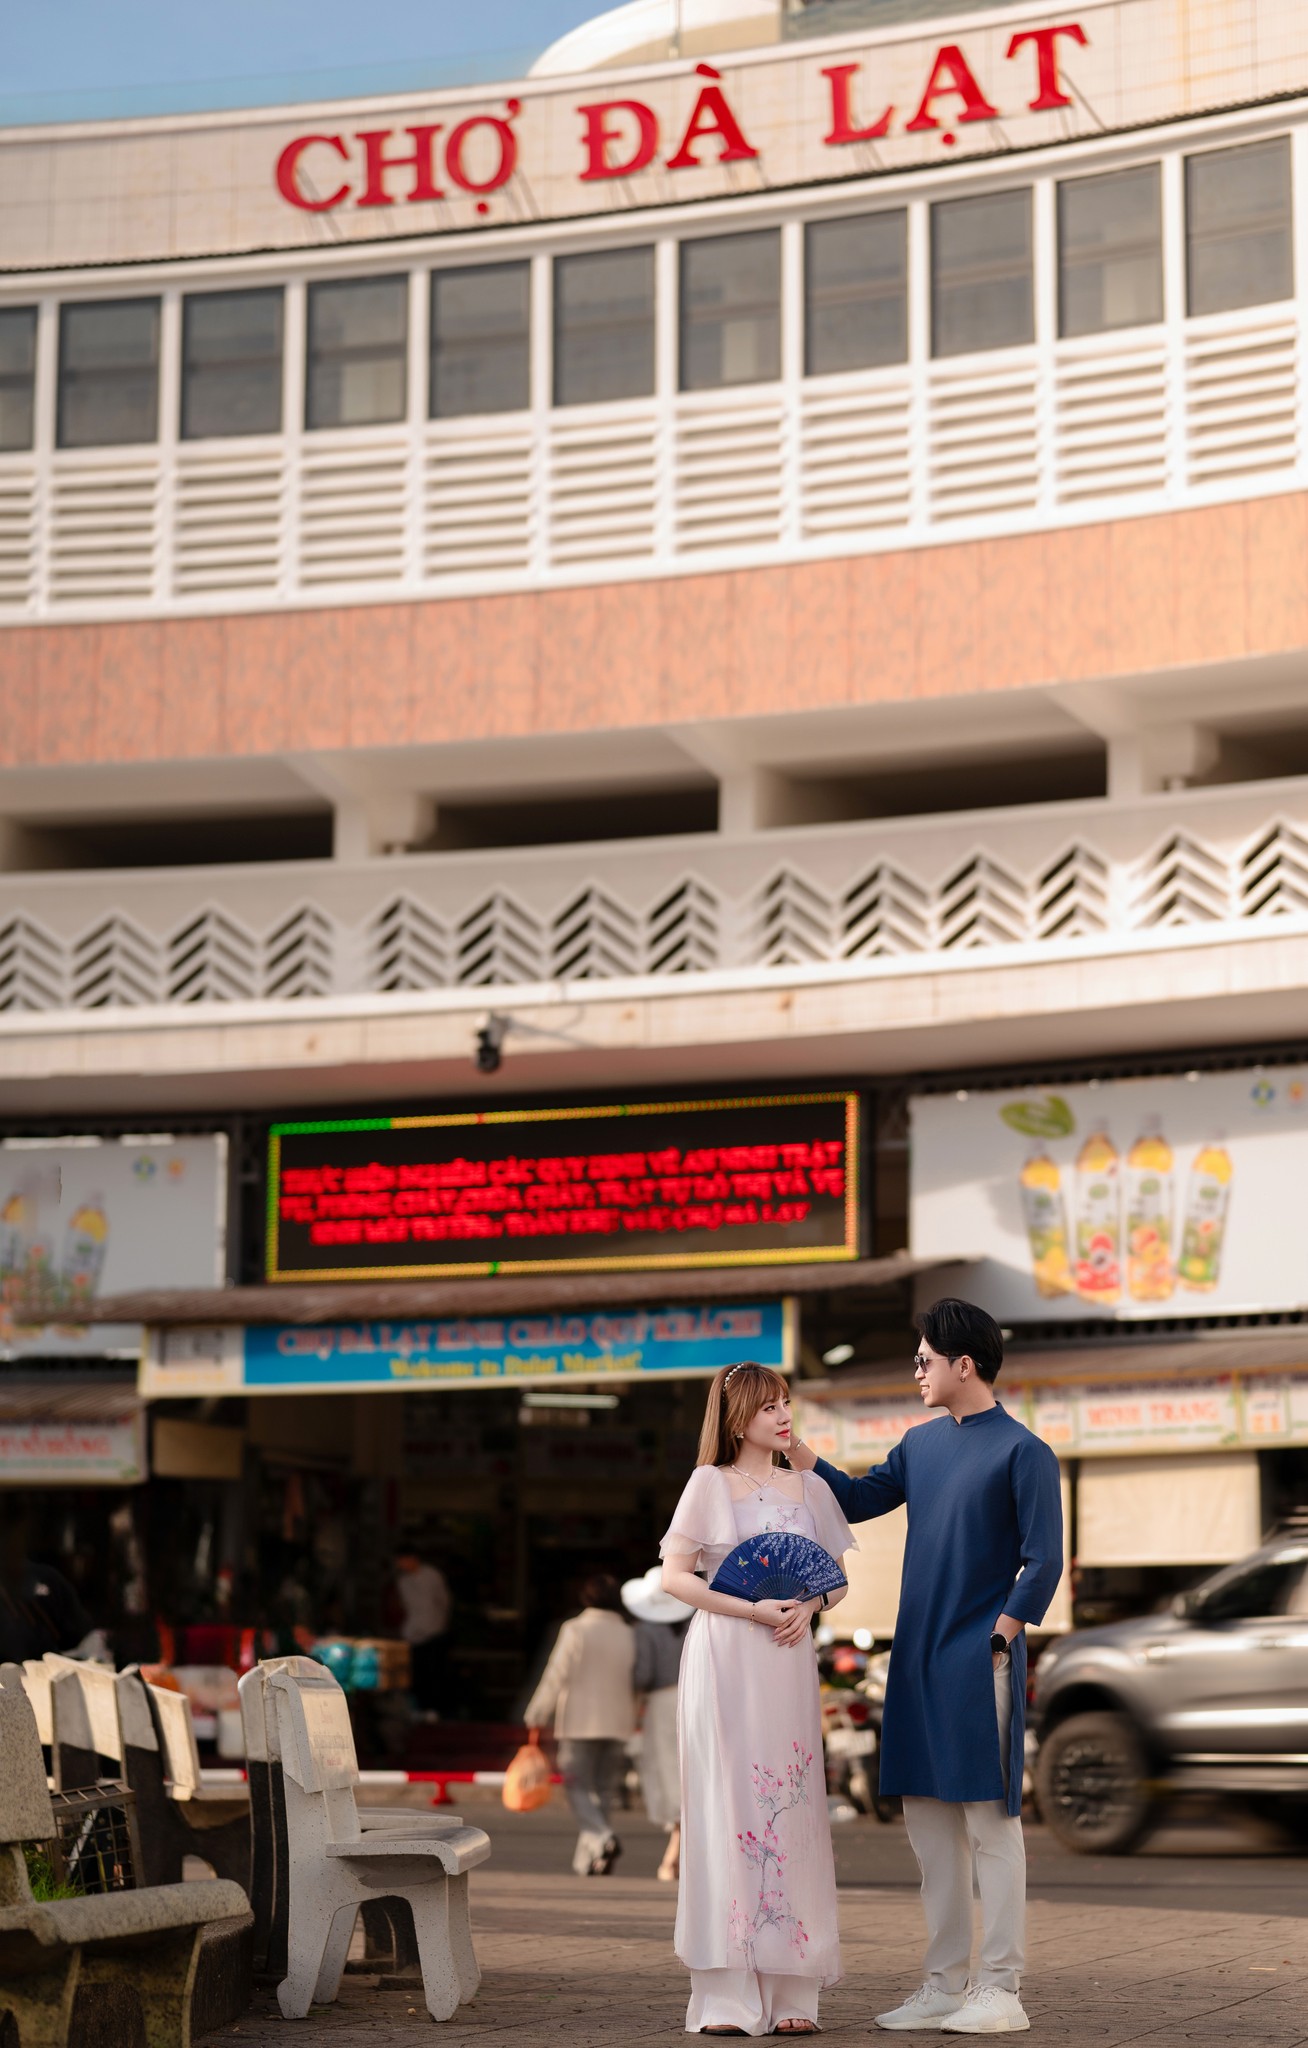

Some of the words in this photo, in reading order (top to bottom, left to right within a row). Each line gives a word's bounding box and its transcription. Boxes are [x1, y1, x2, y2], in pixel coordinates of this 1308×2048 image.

[275, 98, 523, 215] CHỢ
[577, 63, 760, 182] ĐÀ
[820, 24, 1090, 147] LẠT
